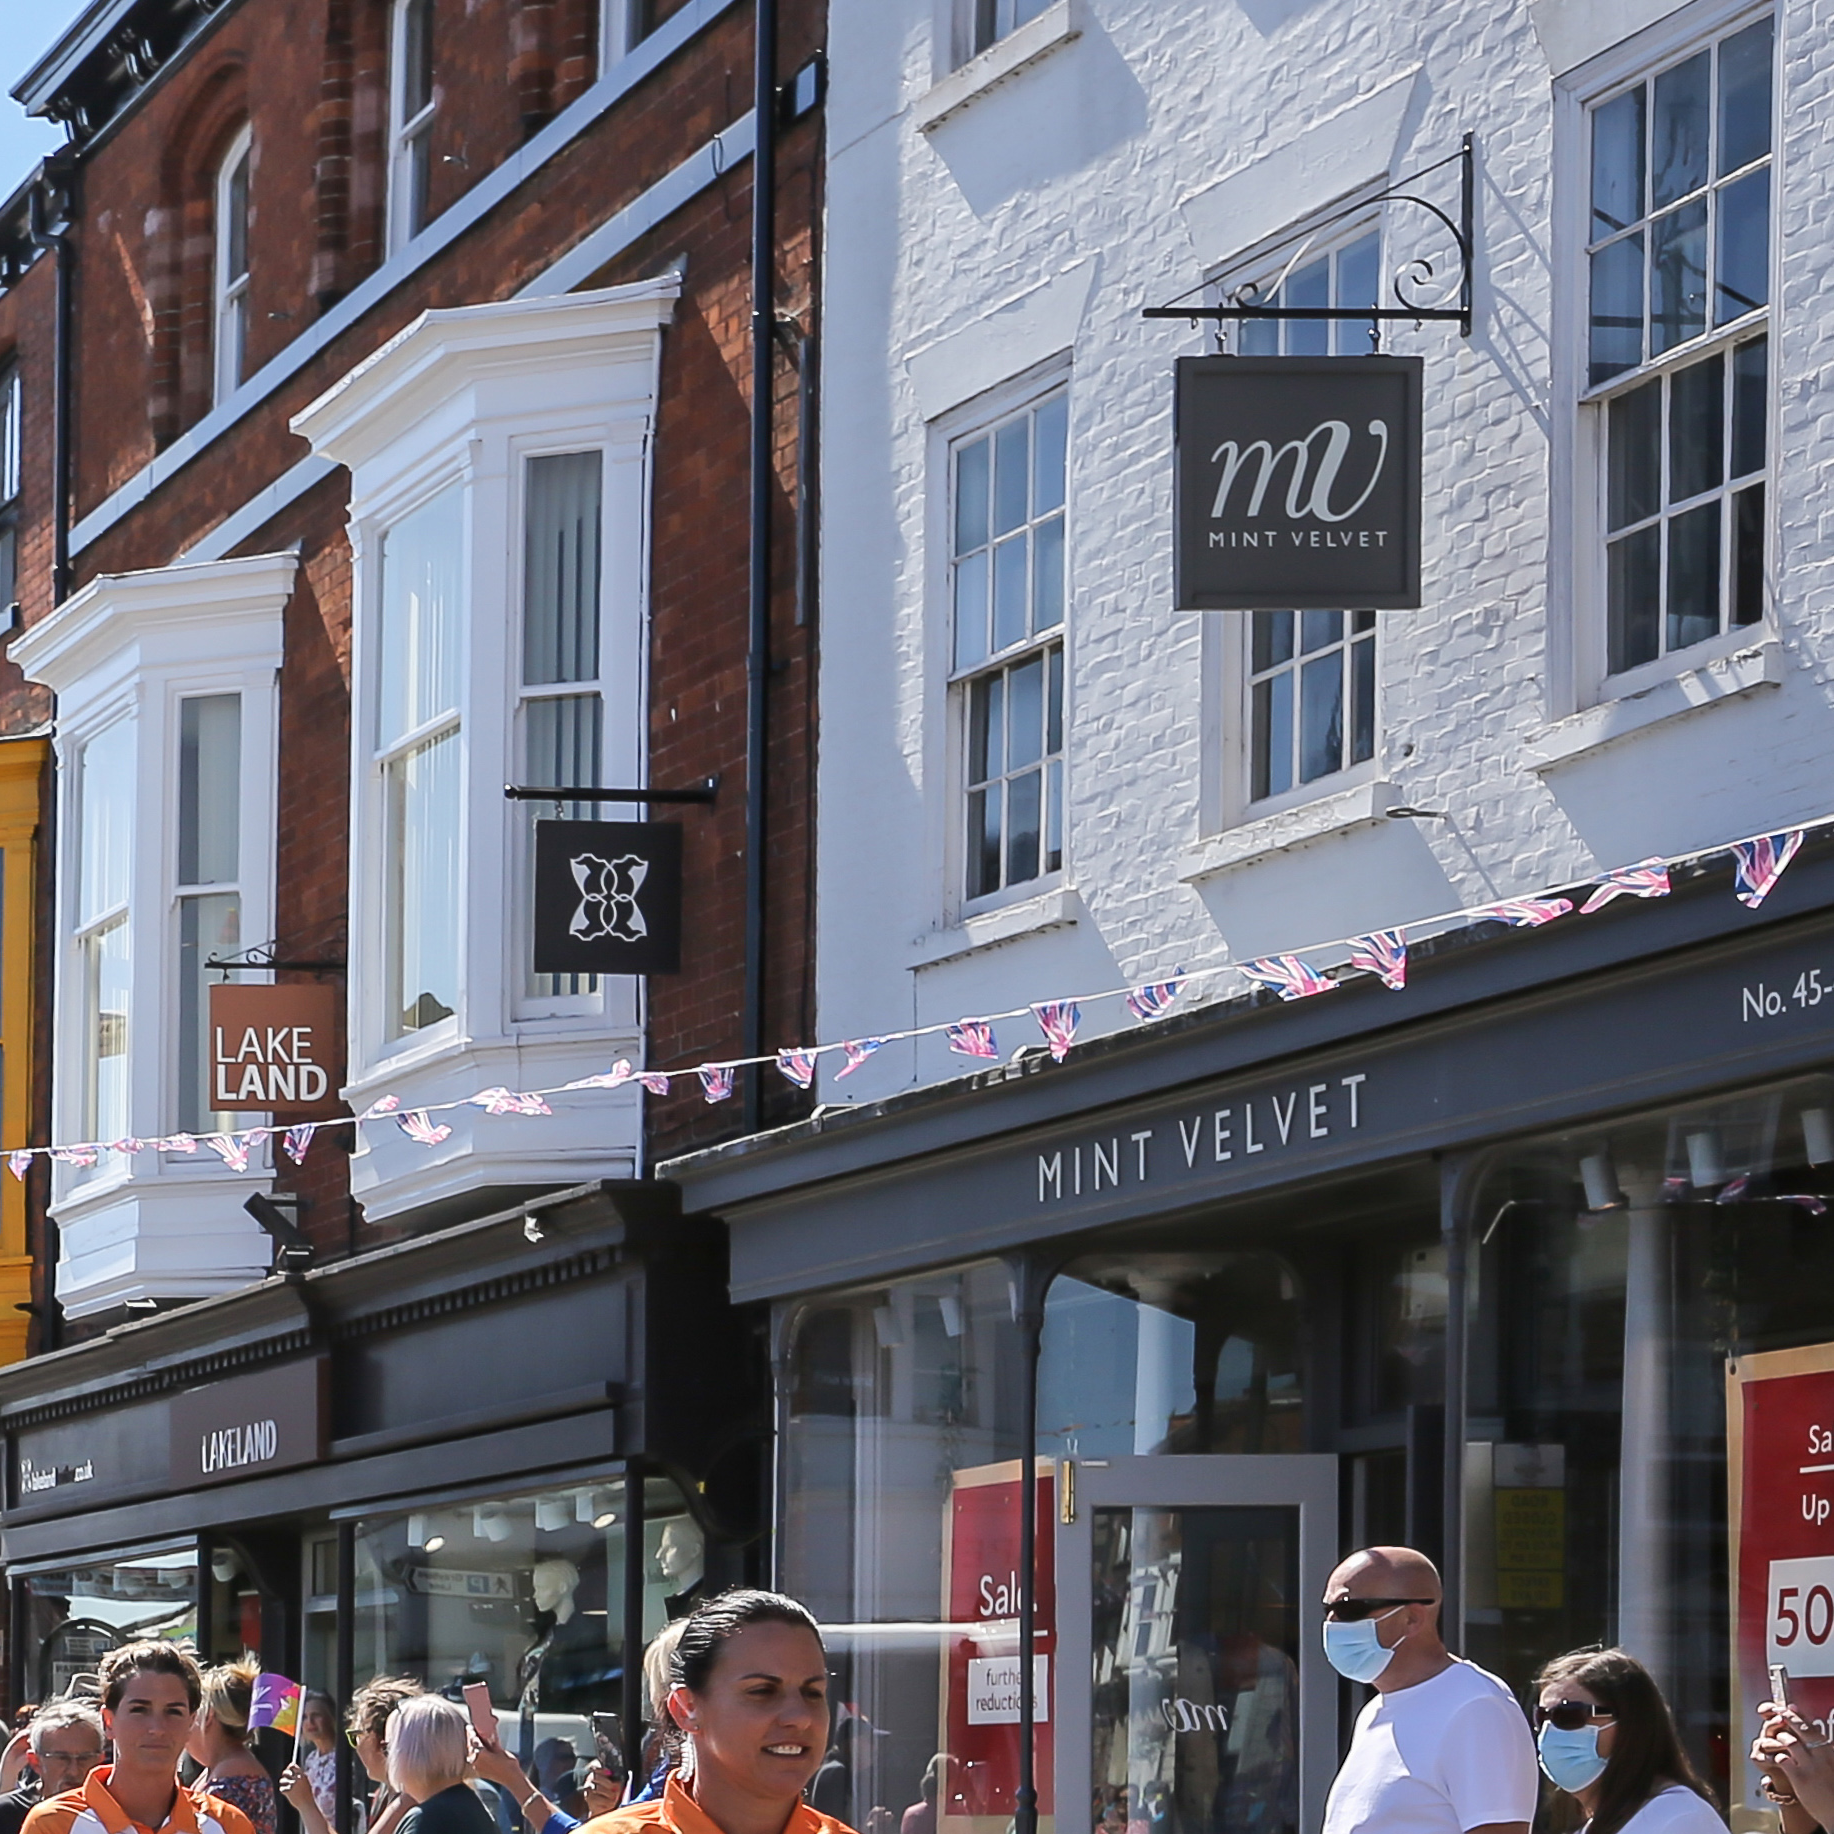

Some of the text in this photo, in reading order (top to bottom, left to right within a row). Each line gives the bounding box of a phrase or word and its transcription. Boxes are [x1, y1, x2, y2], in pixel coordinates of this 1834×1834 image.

[1210, 420, 1387, 523] mv
[1209, 531, 1388, 548] MINT VELVET
[1743, 983, 1786, 1021] No.
[215, 1026, 313, 1064] LAKE
[215, 1063, 328, 1103] LAND
[1039, 1073, 1367, 1202] MINT VELVET
[201, 1419, 278, 1473] LAKELAND
[1803, 1494, 1830, 1525] Up
[980, 1570, 1038, 1616] Sal.
[986, 1667, 1035, 1686] furthe
